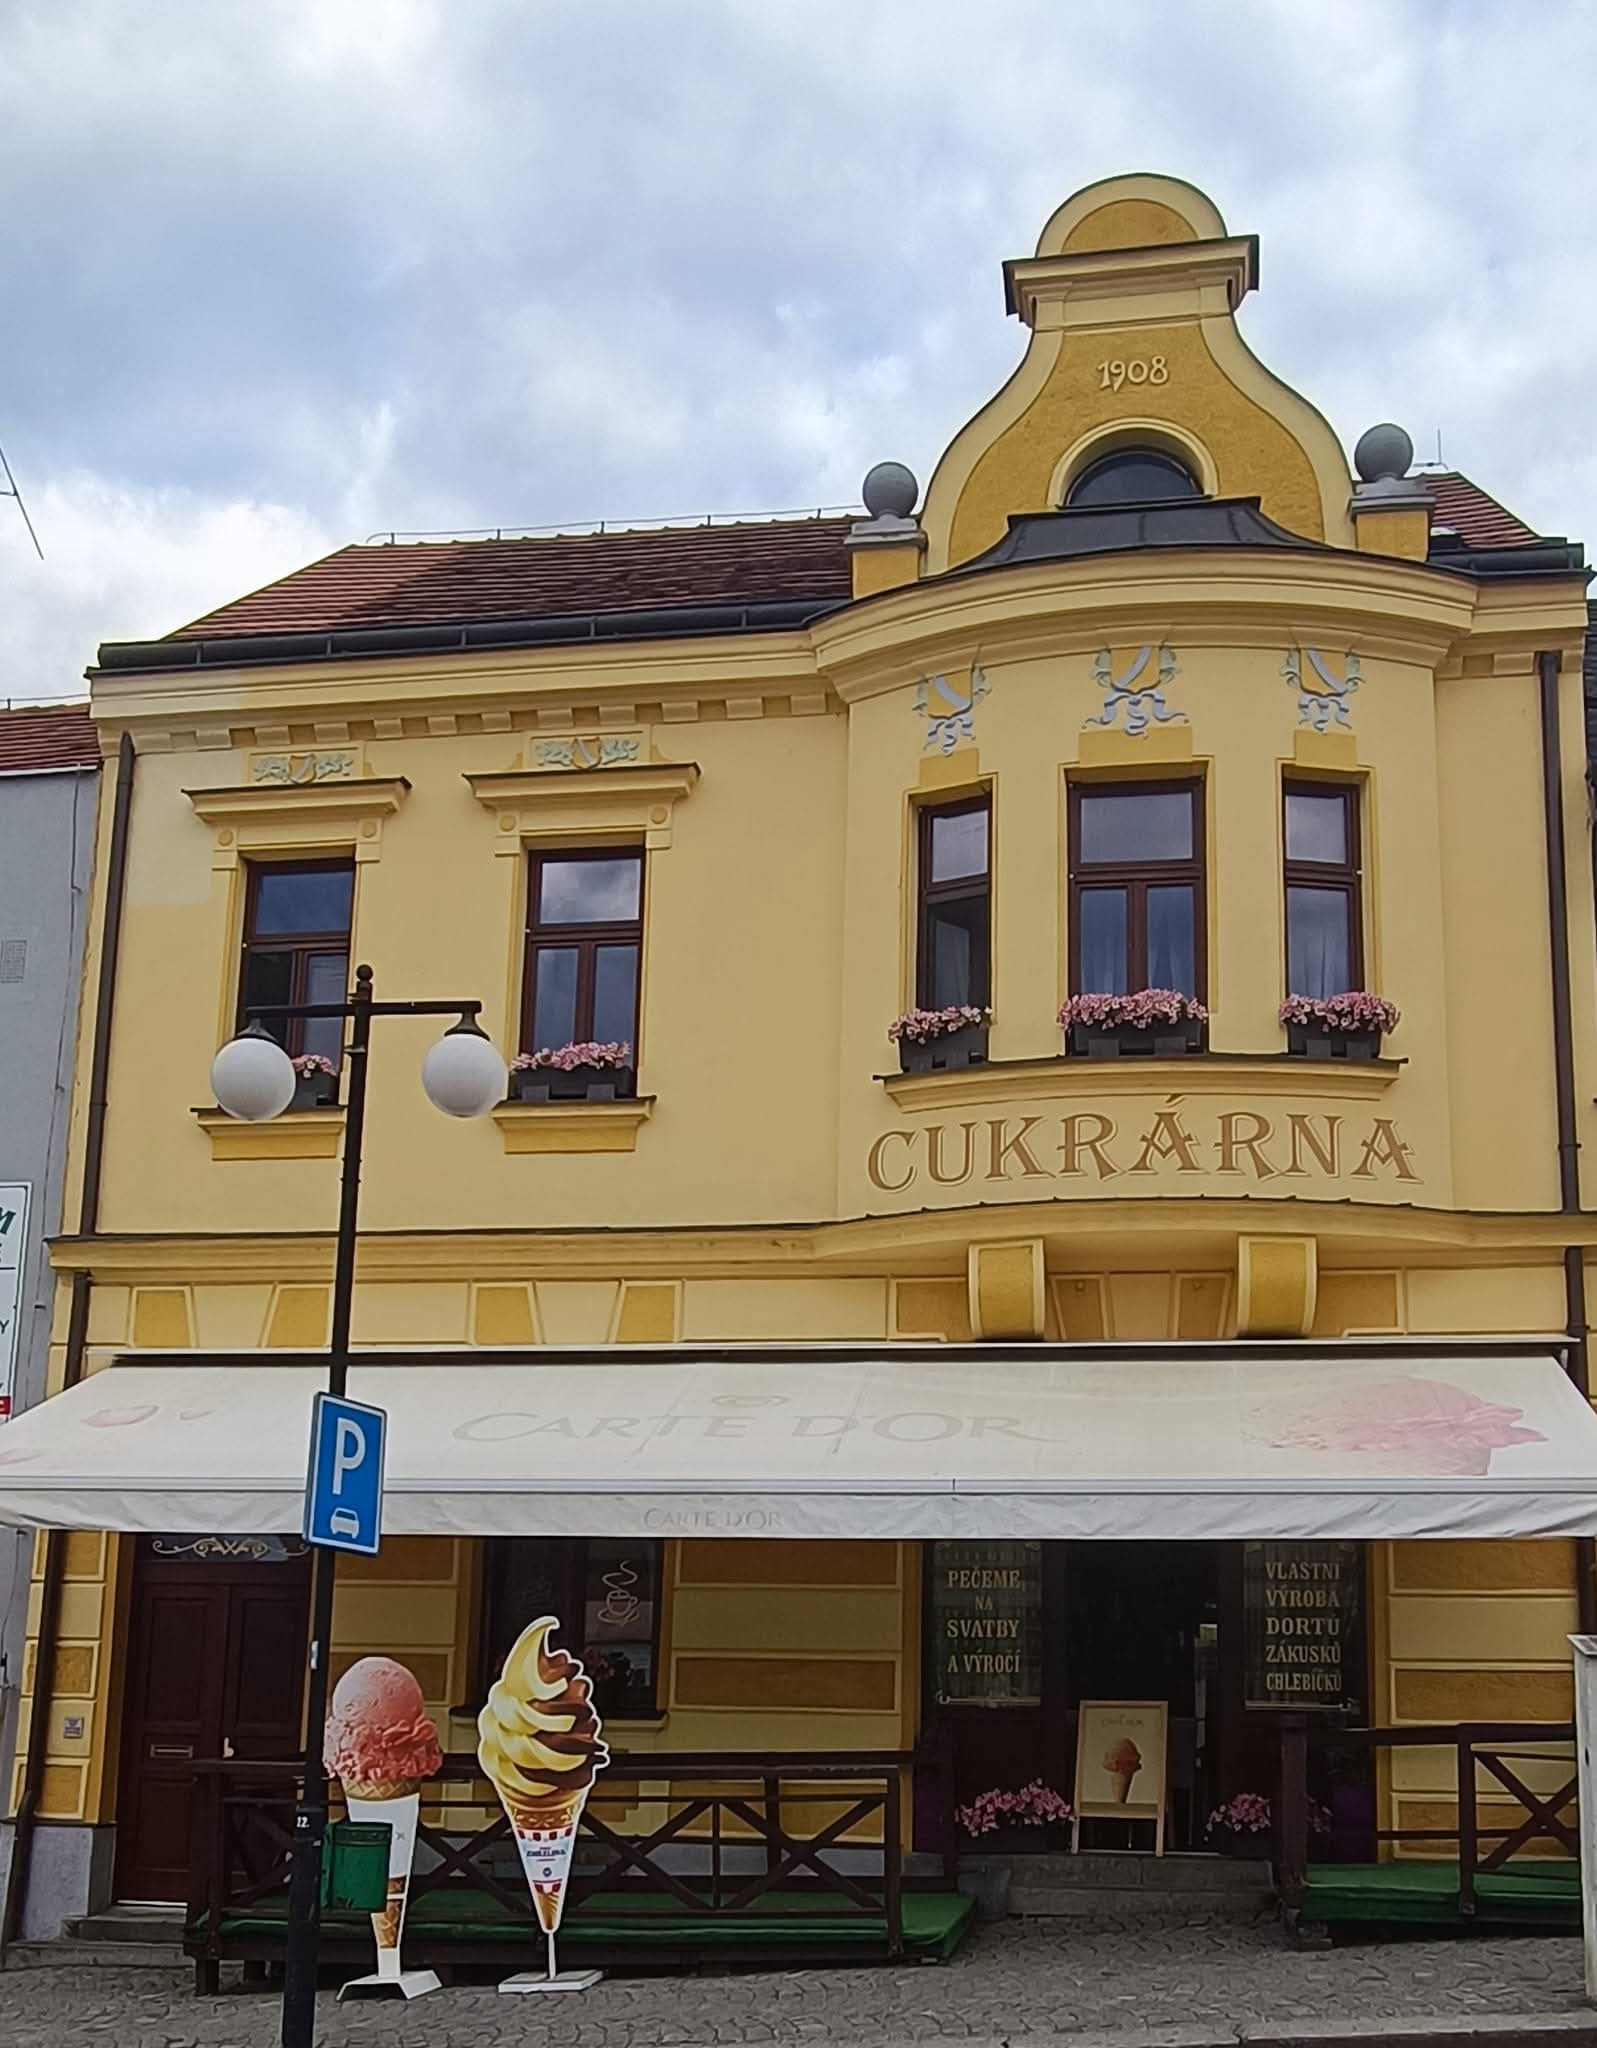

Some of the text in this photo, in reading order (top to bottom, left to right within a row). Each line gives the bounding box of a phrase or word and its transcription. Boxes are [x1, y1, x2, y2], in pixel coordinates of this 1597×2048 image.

[1096, 355, 1169, 392] 1908
[867, 1093, 1423, 1192] CUKRÁRNA
[451, 1410, 1067, 1443] CARTE D'OR
[332, 1417, 366, 1495] P
[644, 1508, 716, 1529] CARTE
[976, 1595, 993, 1610] NA
[1265, 1584, 1340, 1607] VÝROBA
[946, 1619, 1020, 1638] SVATBY
[947, 1648, 1021, 1673] A VÝROČÍ
